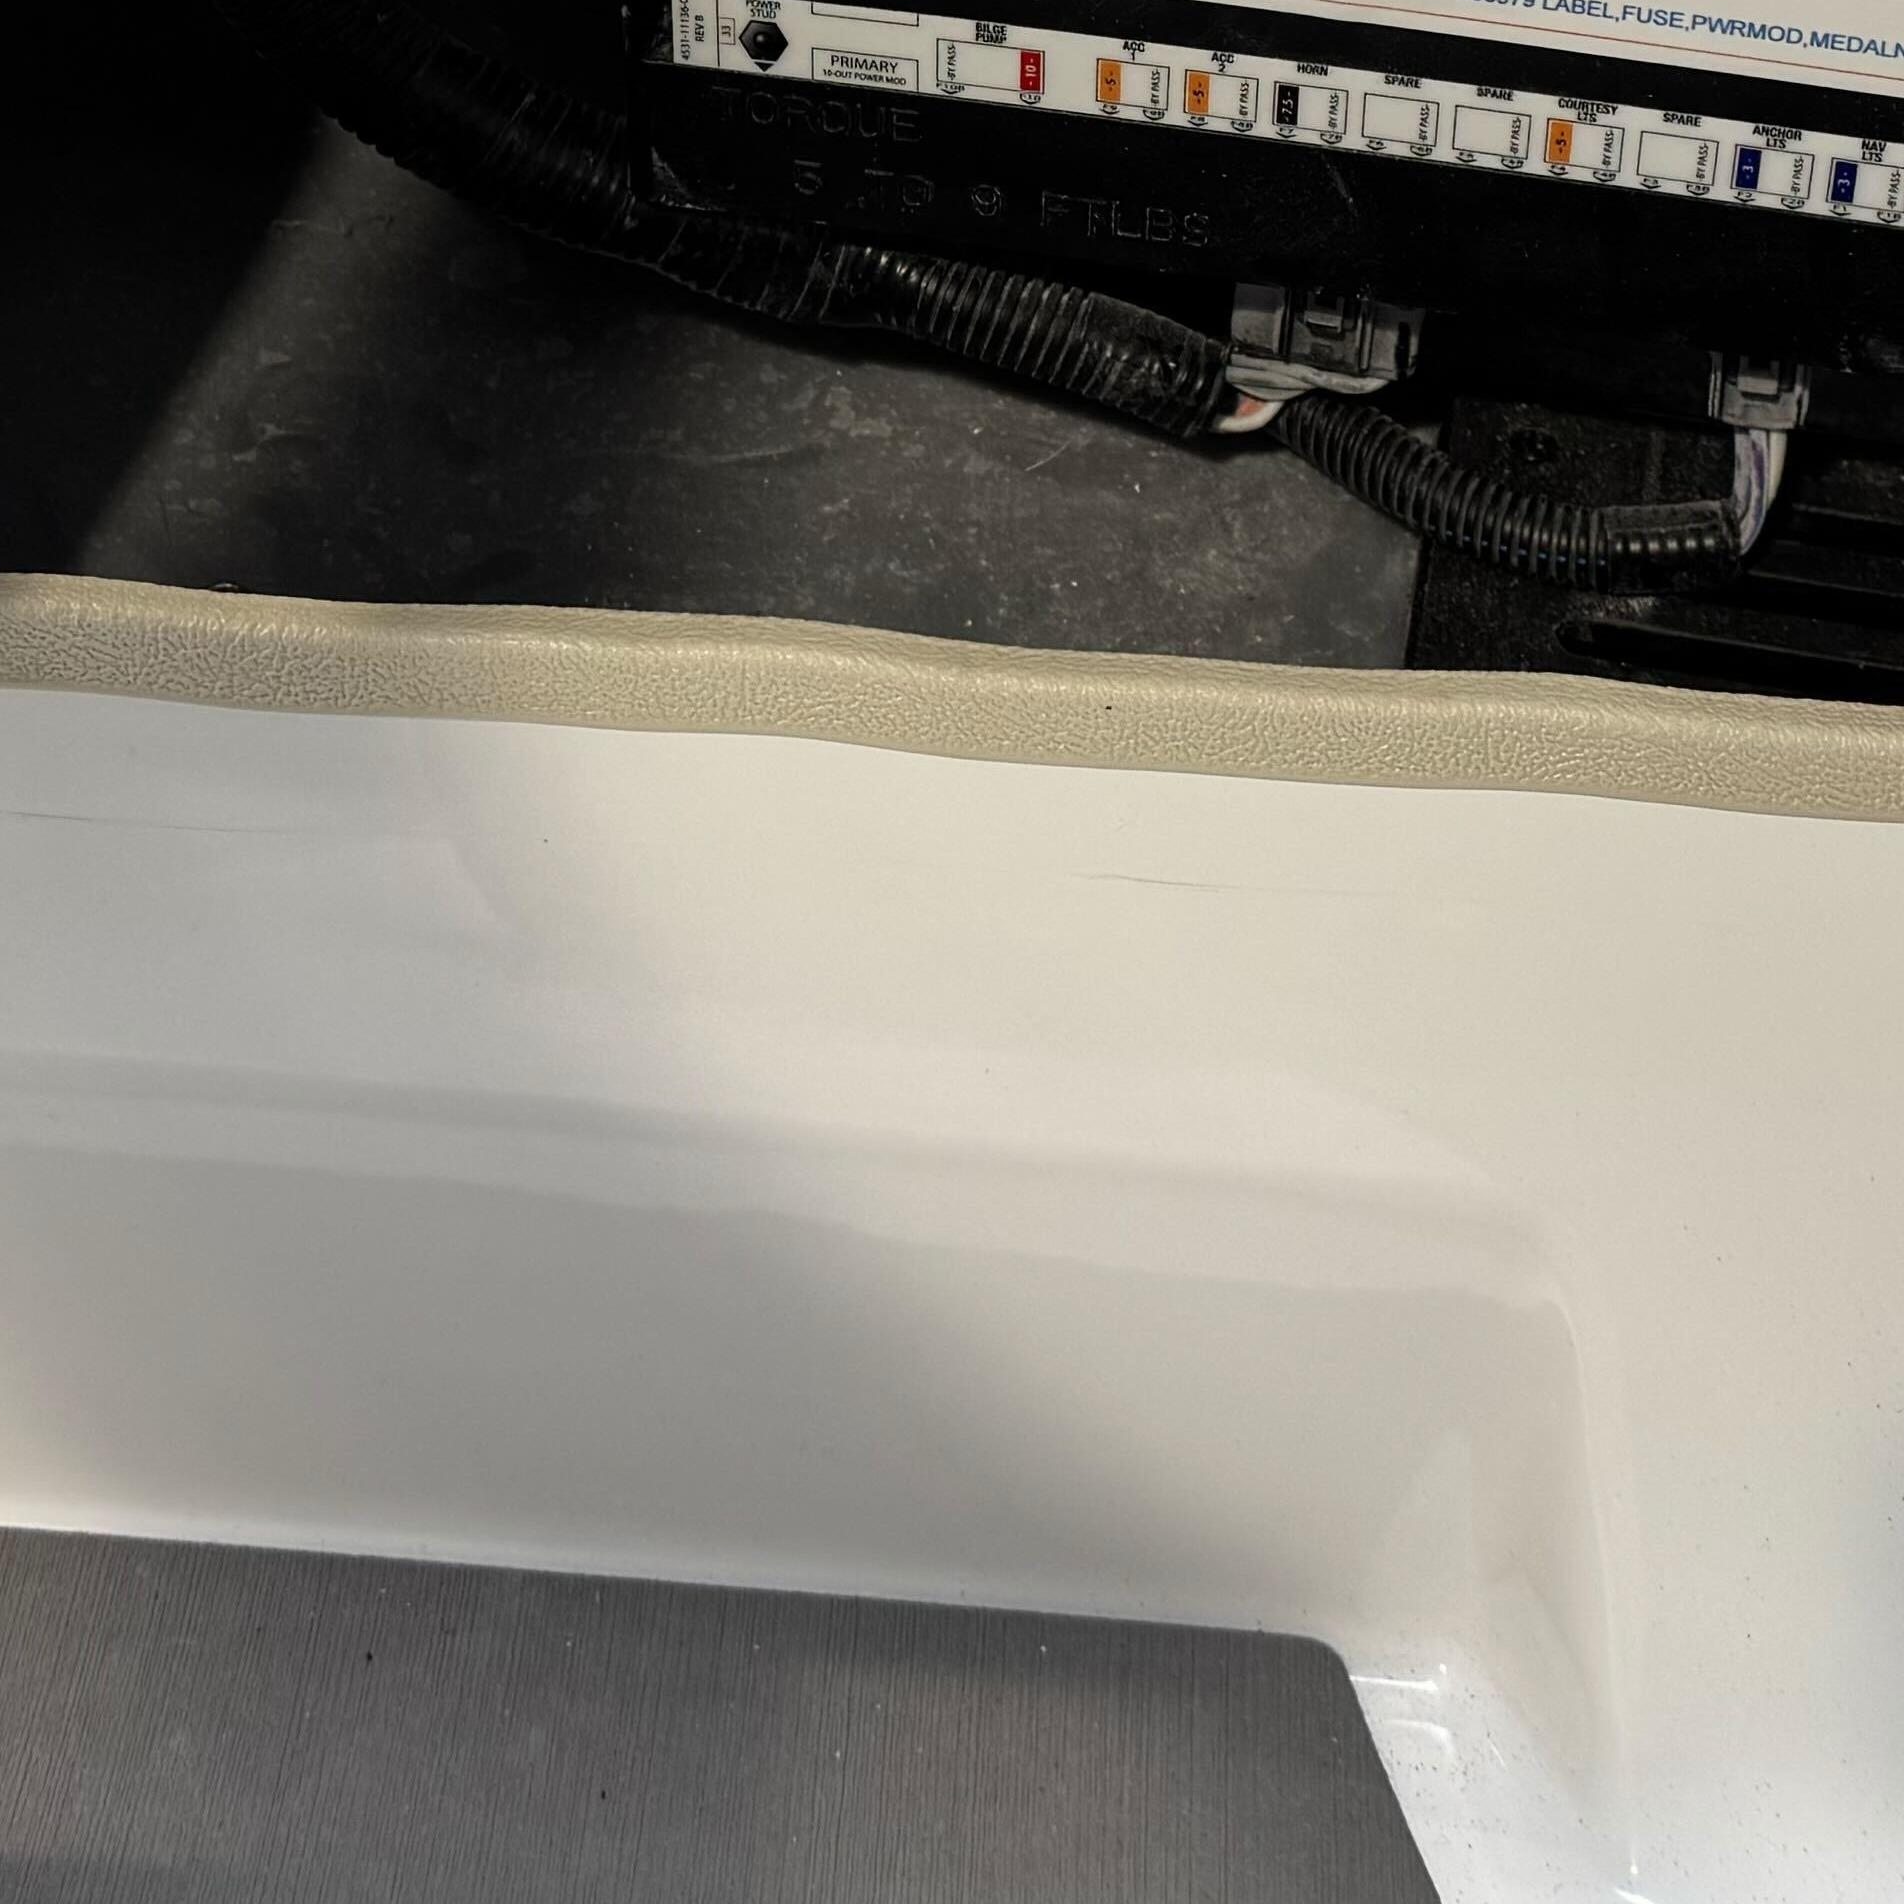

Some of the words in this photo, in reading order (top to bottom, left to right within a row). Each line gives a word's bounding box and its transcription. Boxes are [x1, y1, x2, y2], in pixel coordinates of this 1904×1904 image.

[749, 8, 777, 19] STUD
[695, 24, 705, 42] REV
[975, 21, 1008, 35] BILGE
[975, 31, 1007, 43] PUMP
[1122, 40, 1145, 54] ACC
[830, 53, 899, 75] PRIMARY
[1297, 64, 1329, 78] HORN
[854, 72, 884, 84] POWER
[884, 75, 907, 86] MOD
[1384, 74, 1422, 90] SPARE
[1476, 86, 1514, 102] SPARE
[1558, 97, 1619, 116] COURTESY
[712, 84, 924, 144] TORQUE
[1577, 111, 1598, 123] LTS
[1663, 112, 1702, 128] SPARE
[1752, 124, 1802, 142] ANCHOR
[1766, 137, 1787, 150] LTS
[1861, 139, 1887, 153] NAV
[1861, 150, 1884, 163] LTS
[793, 158, 825, 196] 5
[970, 182, 1005, 218] 9
